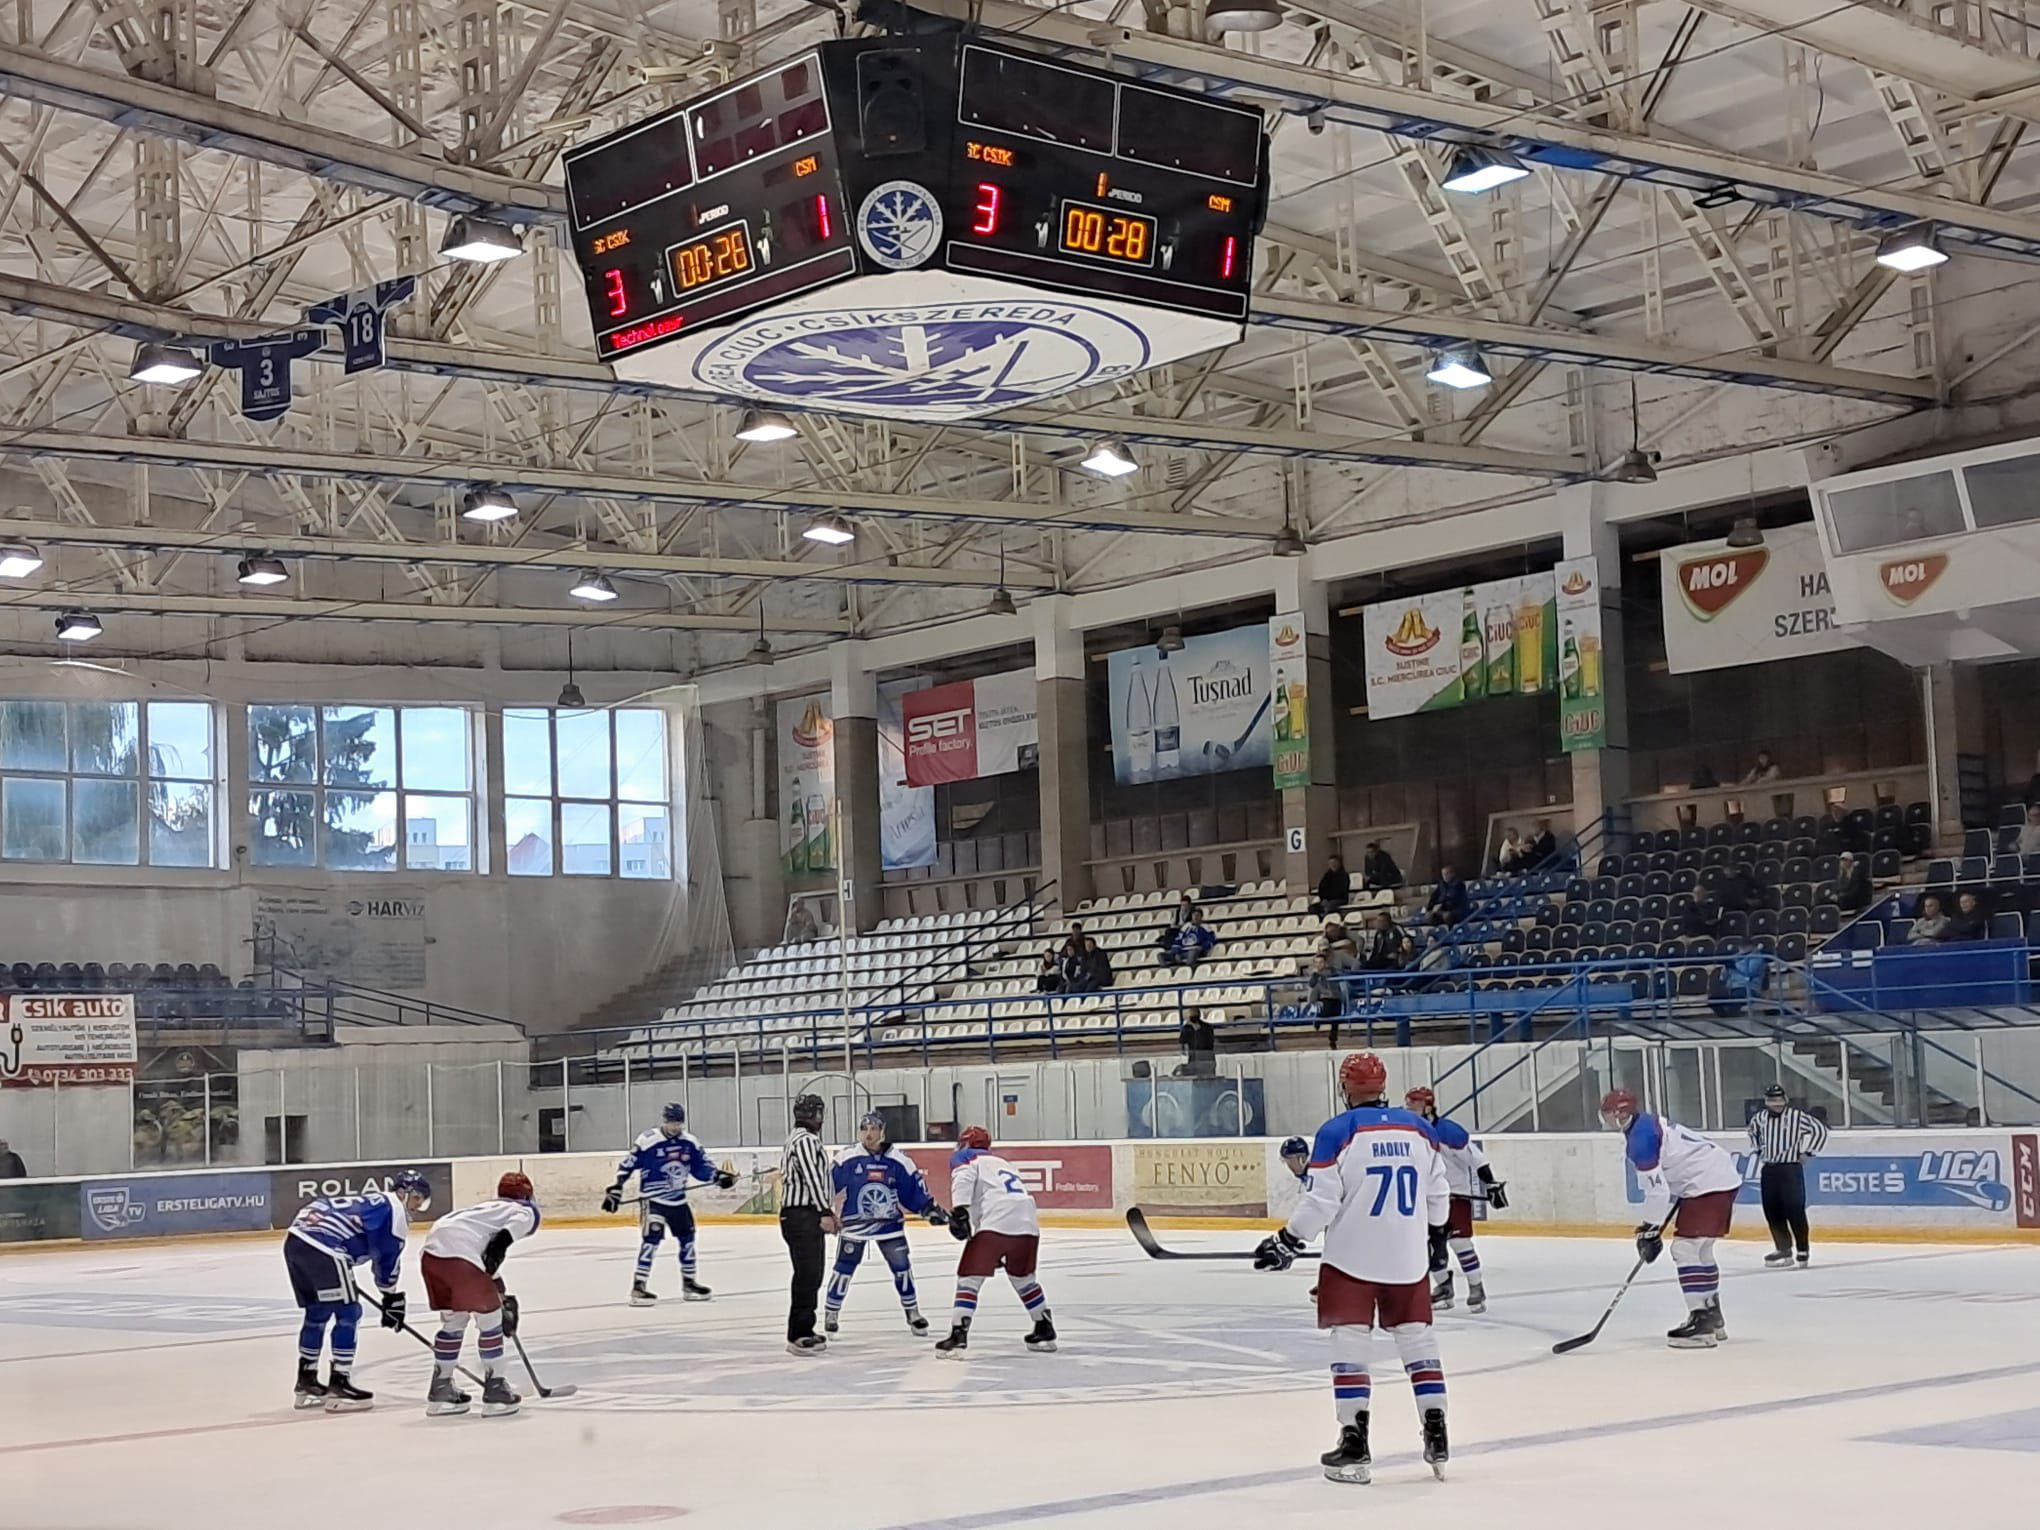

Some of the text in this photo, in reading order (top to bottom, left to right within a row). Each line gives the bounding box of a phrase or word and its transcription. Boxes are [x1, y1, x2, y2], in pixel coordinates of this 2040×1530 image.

[816, 194, 831, 239] 1
[974, 183, 999, 234] 3
[1208, 194, 1231, 213] CSM
[1066, 208, 1147, 260] 00:28
[1222, 236, 1235, 279] 1
[605, 269, 627, 317] 3
[350, 312, 374, 347] 18
[720, 306, 1077, 361] CIUC CSÍKSZEREDA
[260, 359, 274, 387] 3
[1690, 561, 1738, 591] MOL
[1888, 562, 1927, 586] MOL
[1436, 664, 1457, 676] CIUC
[908, 708, 971, 742] SET
[1290, 829, 1302, 850] G
[80, 1068, 106, 1081] 303
[109, 1067, 133, 1080] 333
[1153, 1156, 1230, 1185] FENYŐ
[1918, 1151, 1997, 1182] LIGA
[2019, 1142, 2035, 1218] CCM
[1366, 1165, 1418, 1217] 70
[1818, 1171, 1881, 1193] ERSTE
[128, 1206, 142, 1216] TV
[157, 1195, 265, 1212] ERSTELIGATV.HU
